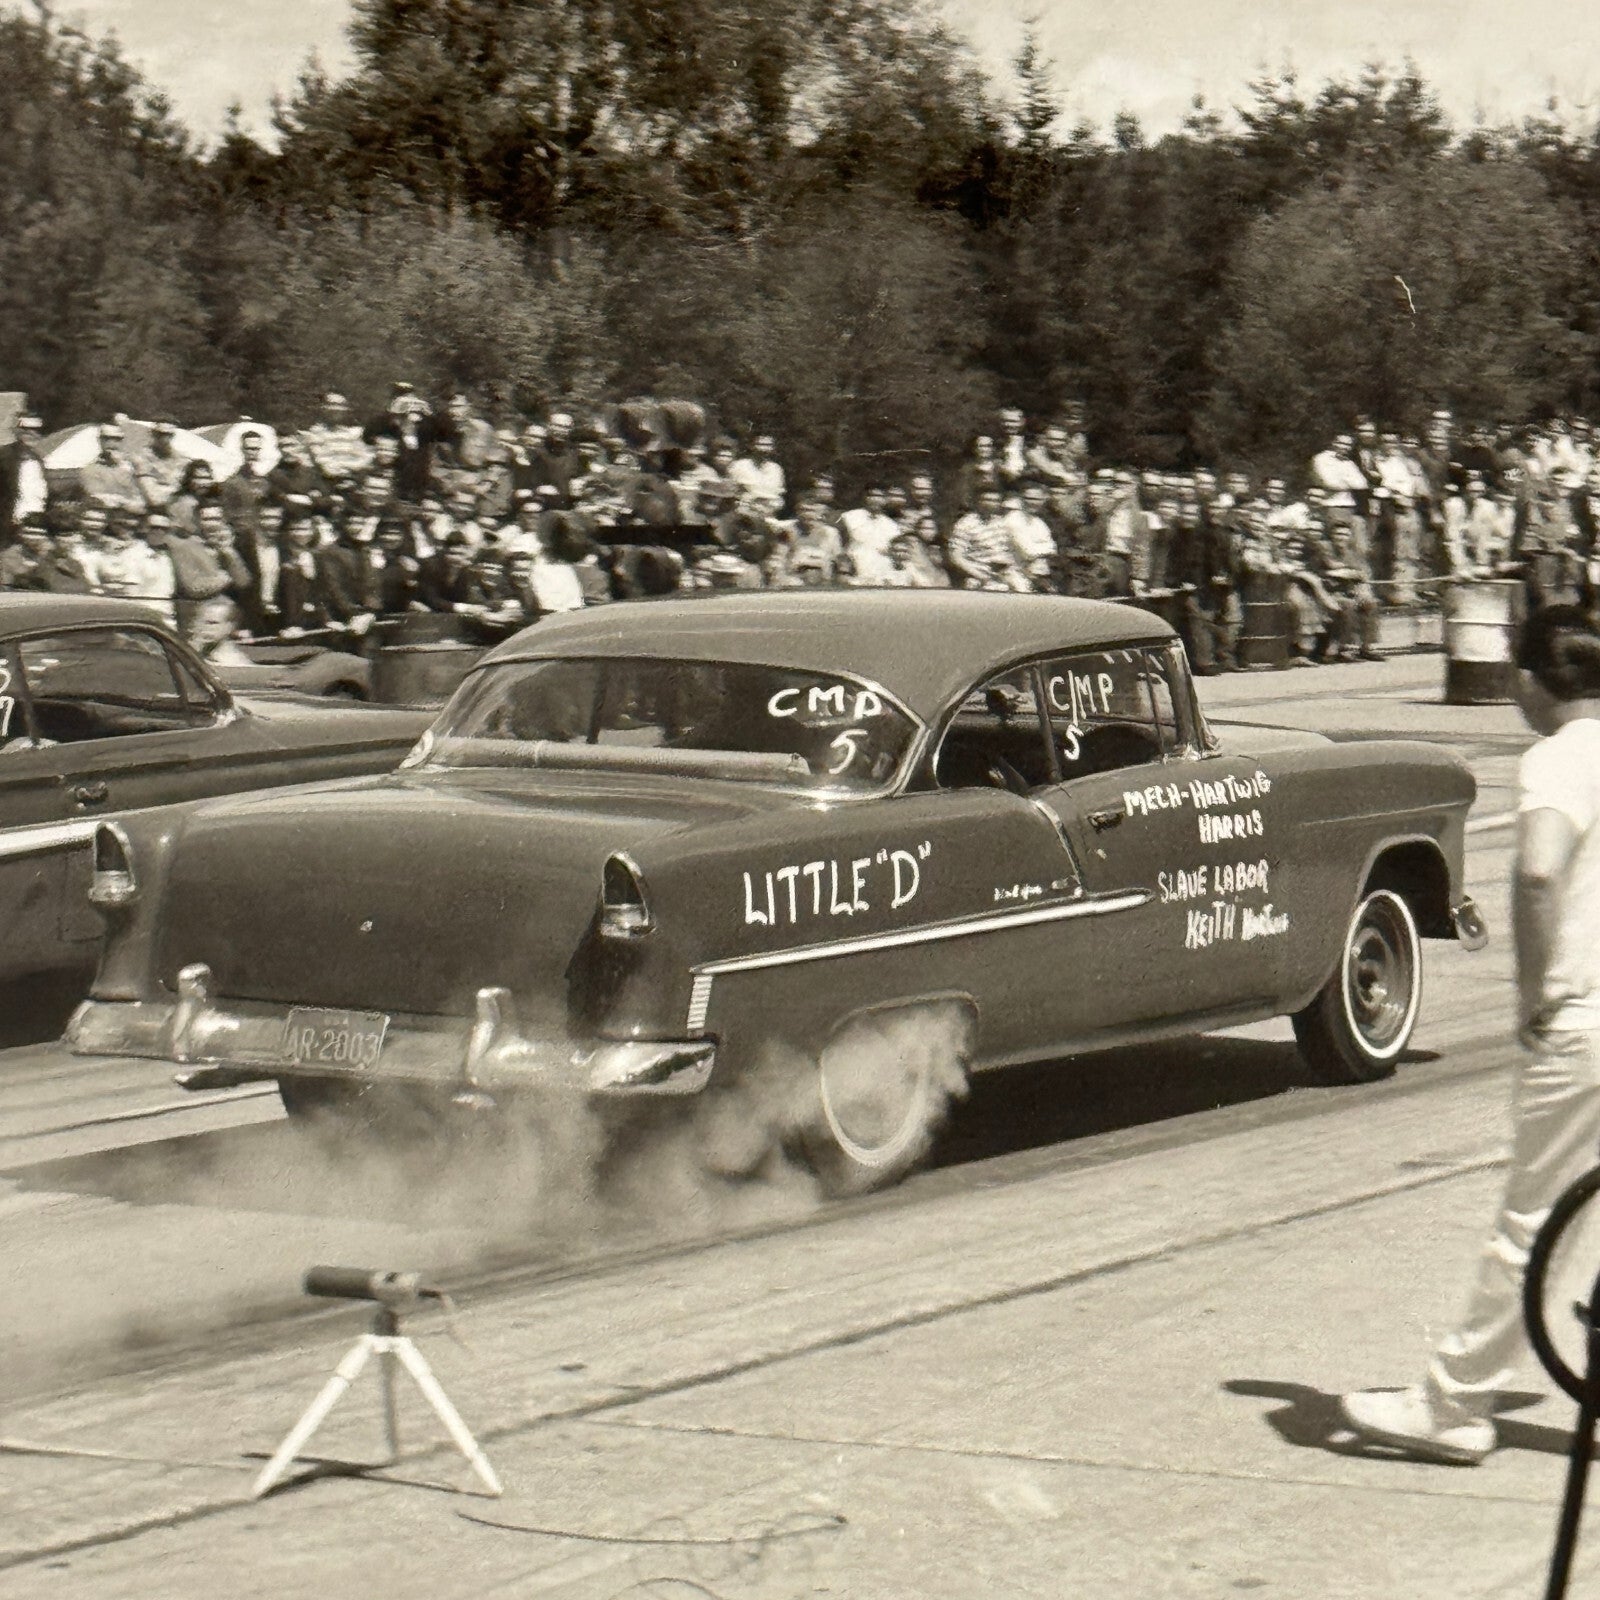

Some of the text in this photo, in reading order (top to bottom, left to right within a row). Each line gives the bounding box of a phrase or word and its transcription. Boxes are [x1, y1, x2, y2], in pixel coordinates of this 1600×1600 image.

[829, 728, 868, 774] 5
[1198, 809, 1264, 843] HARRIS
[743, 860, 871, 925] LITTLE
[1214, 859, 1269, 895] LABOR
[1185, 901, 1237, 949] KEITH
